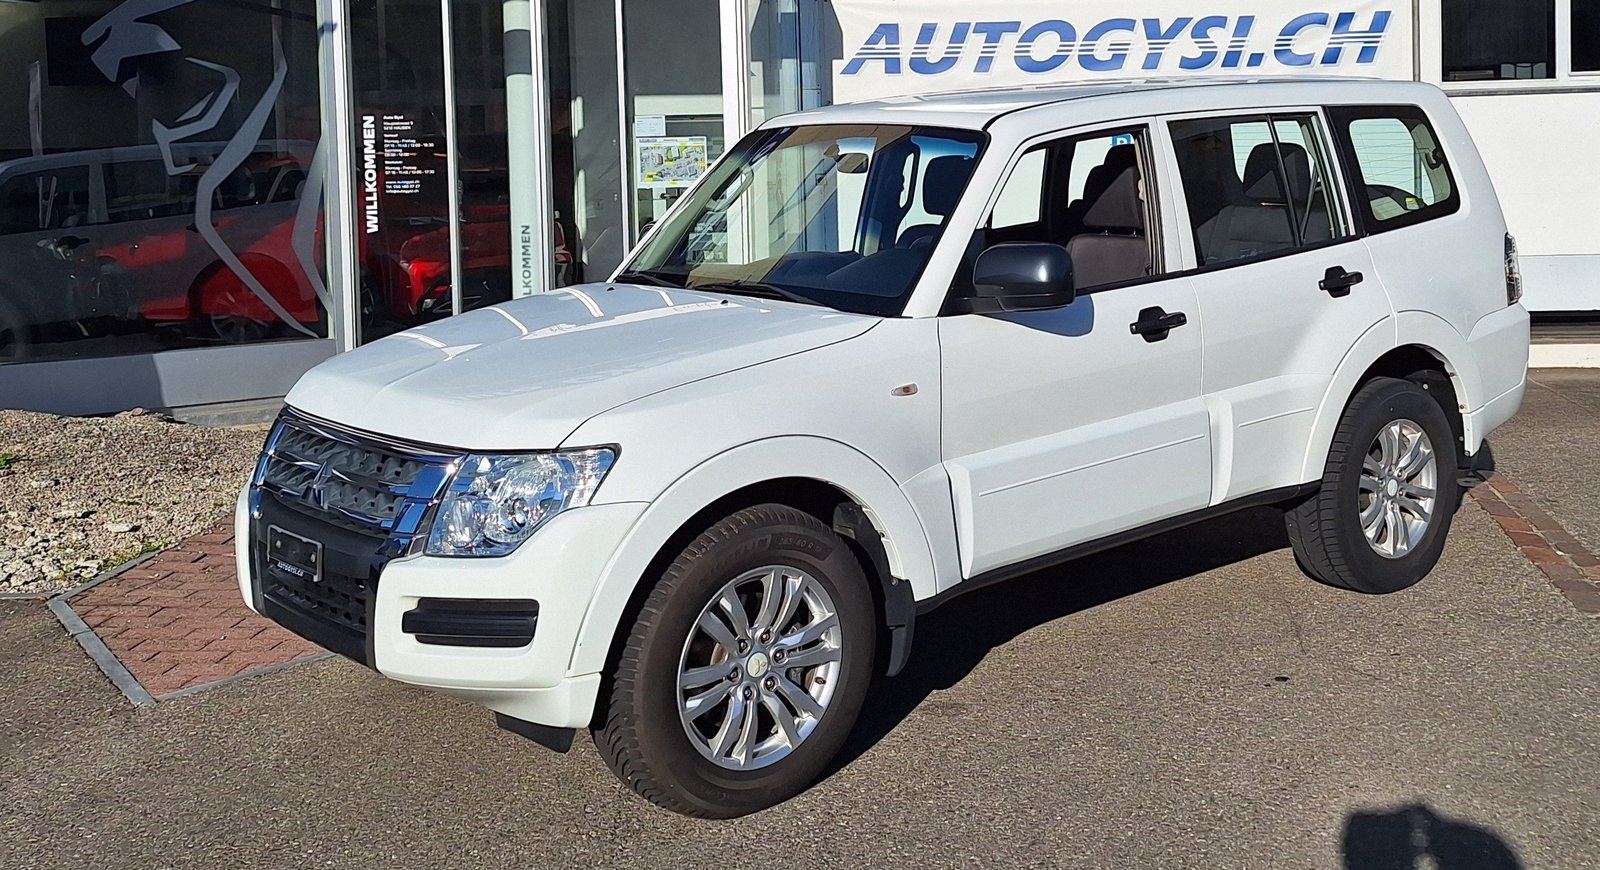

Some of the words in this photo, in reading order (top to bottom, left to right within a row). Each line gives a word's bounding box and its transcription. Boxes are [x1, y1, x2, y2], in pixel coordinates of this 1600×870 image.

[839, 10, 1391, 75] AUTOGYSI.CH
[362, 115, 379, 234] WILLKOMMEN
[521, 225, 532, 295] LKOMMEN
